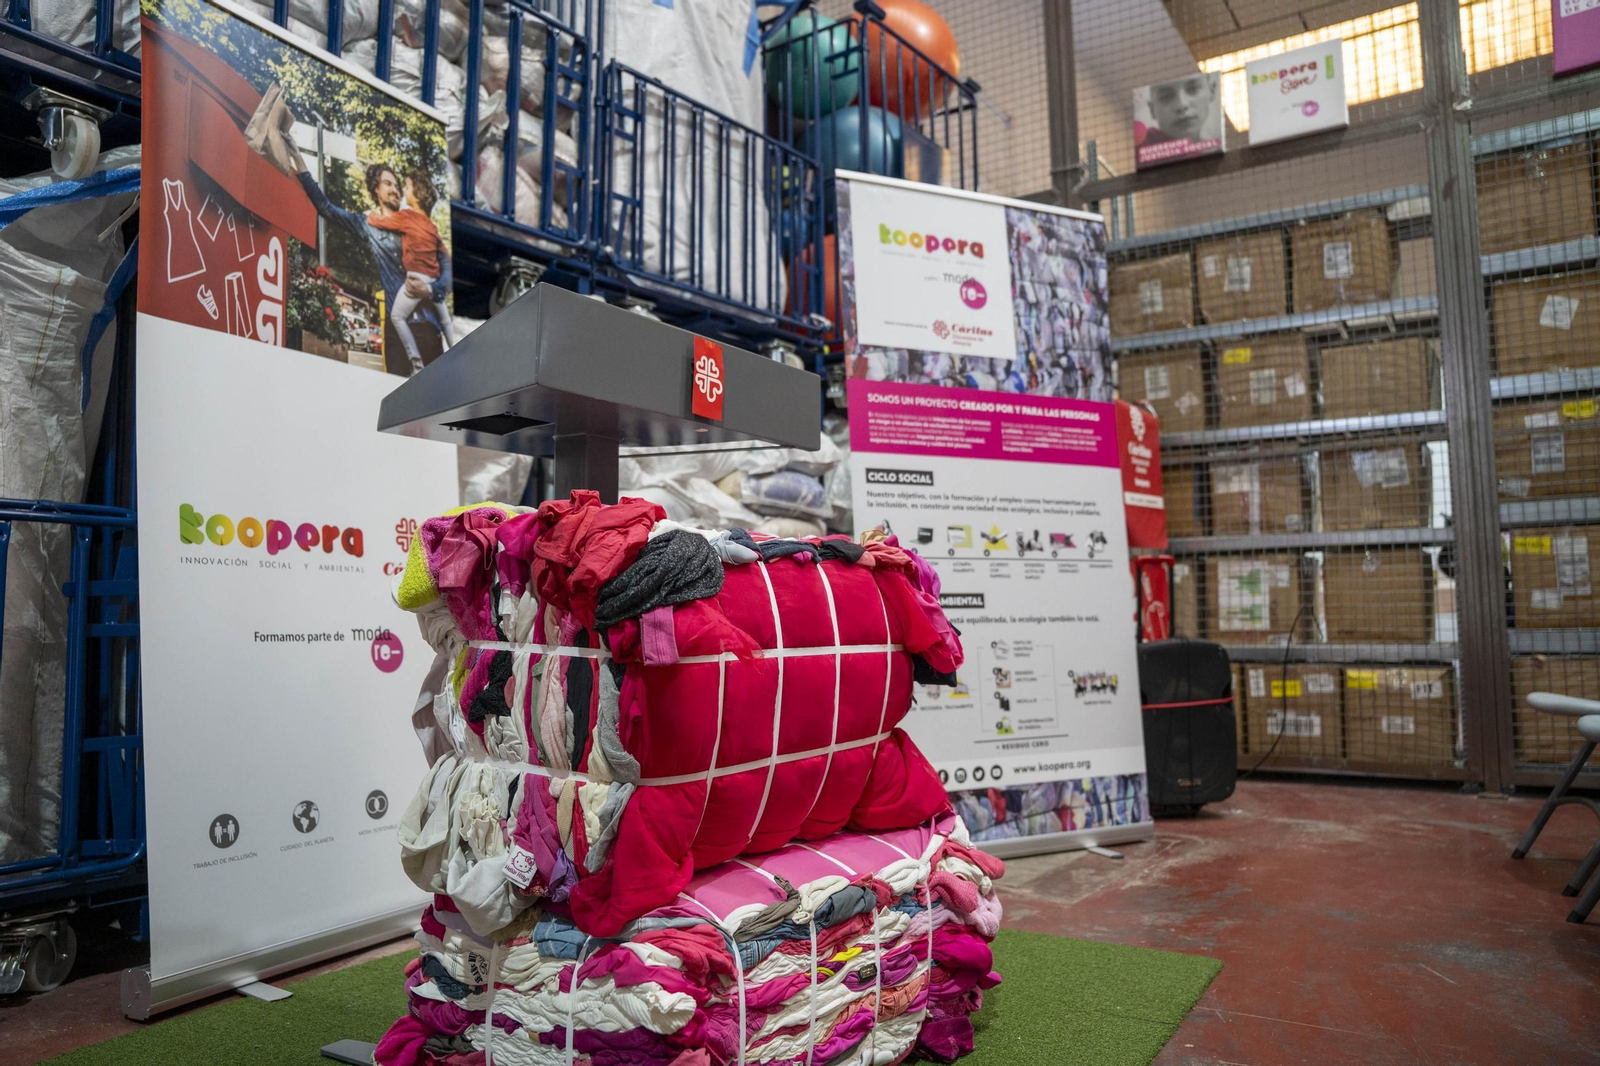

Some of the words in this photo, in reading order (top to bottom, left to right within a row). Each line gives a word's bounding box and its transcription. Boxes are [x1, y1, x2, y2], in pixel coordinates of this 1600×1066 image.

[1251, 61, 1317, 85] koopera
[879, 223, 984, 259] koopera
[952, 323, 993, 336] Cáritas
[867, 393, 899, 404] SOMOS
[900, 396, 914, 405] UN
[915, 396, 958, 409] PROYECTO
[959, 400, 995, 413] CREADO
[996, 404, 1014, 414] POR
[1015, 406, 1021, 414] Y
[1021, 406, 1043, 417] PARA
[1044, 408, 1059, 418] LAS
[1060, 409, 1100, 422] PERSONAS
[867, 471, 896, 482] CICLO
[898, 473, 932, 484] SOCIAL
[866, 490, 895, 499] Nuestro
[897, 492, 926, 500] objetivo,
[951, 494, 984, 503] formación
[1042, 498, 1081, 506] herramientas
[875, 501, 909, 510] inclusión,
[919, 502, 950, 510] construir
[966, 504, 994, 512] sociedad
[1010, 506, 1041, 515] ecológica,
[179, 503, 365, 558] koopera
[180, 556, 248, 567] INNOVACIÓN
[259, 560, 293, 570] SOCIAL
[318, 564, 365, 574] AMBIENTAL
[383, 561, 404, 576] Cá
[966, 616, 1008, 625] equilibrada,
[1010, 615, 1016, 623] la
[1018, 616, 1047, 625] ecología
[1048, 614, 1075, 623] también
[1077, 614, 1083, 622] lo
[1085, 614, 1100, 622] está.
[254, 631, 305, 642] Formamos
[307, 632, 332, 644] parte
[333, 631, 345, 642] de
[351, 626, 392, 641] moda
[1001, 741, 1030, 750] RESIDUO
[1031, 740, 1050, 748] CERO
[1013, 759, 1091, 775] www.koopera.org
[279, 842, 303, 852] CUIDADO
[314, 836, 335, 845] PLANETA
[193, 859, 219, 870] TRABAJO
[219, 857, 227, 865] DE
[227, 851, 258, 863] INCLUSIÓN
